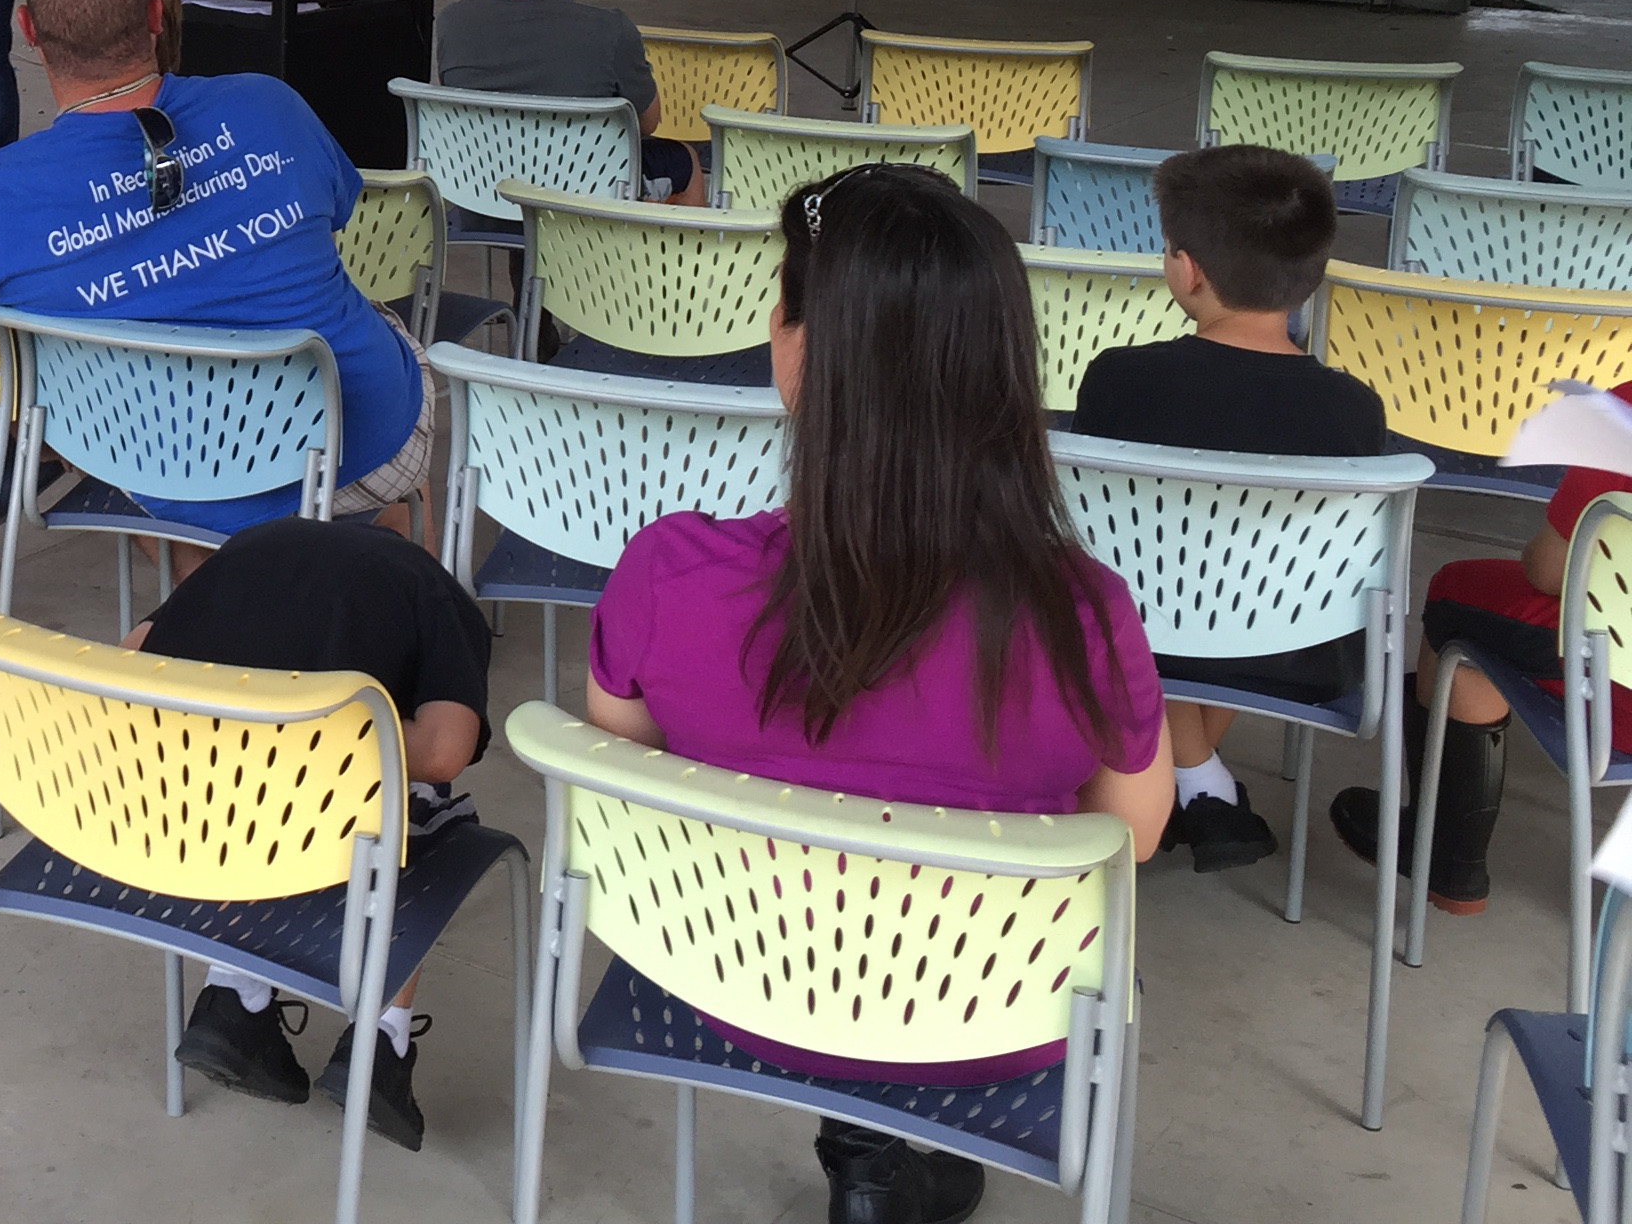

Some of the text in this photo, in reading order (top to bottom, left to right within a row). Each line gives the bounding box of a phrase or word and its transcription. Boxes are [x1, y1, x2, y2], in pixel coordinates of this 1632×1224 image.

[48, 151, 295, 256] Global Manacturing Day...
[89, 122, 236, 203] In Recition of
[76, 200, 304, 306] WE THANK YOU!
